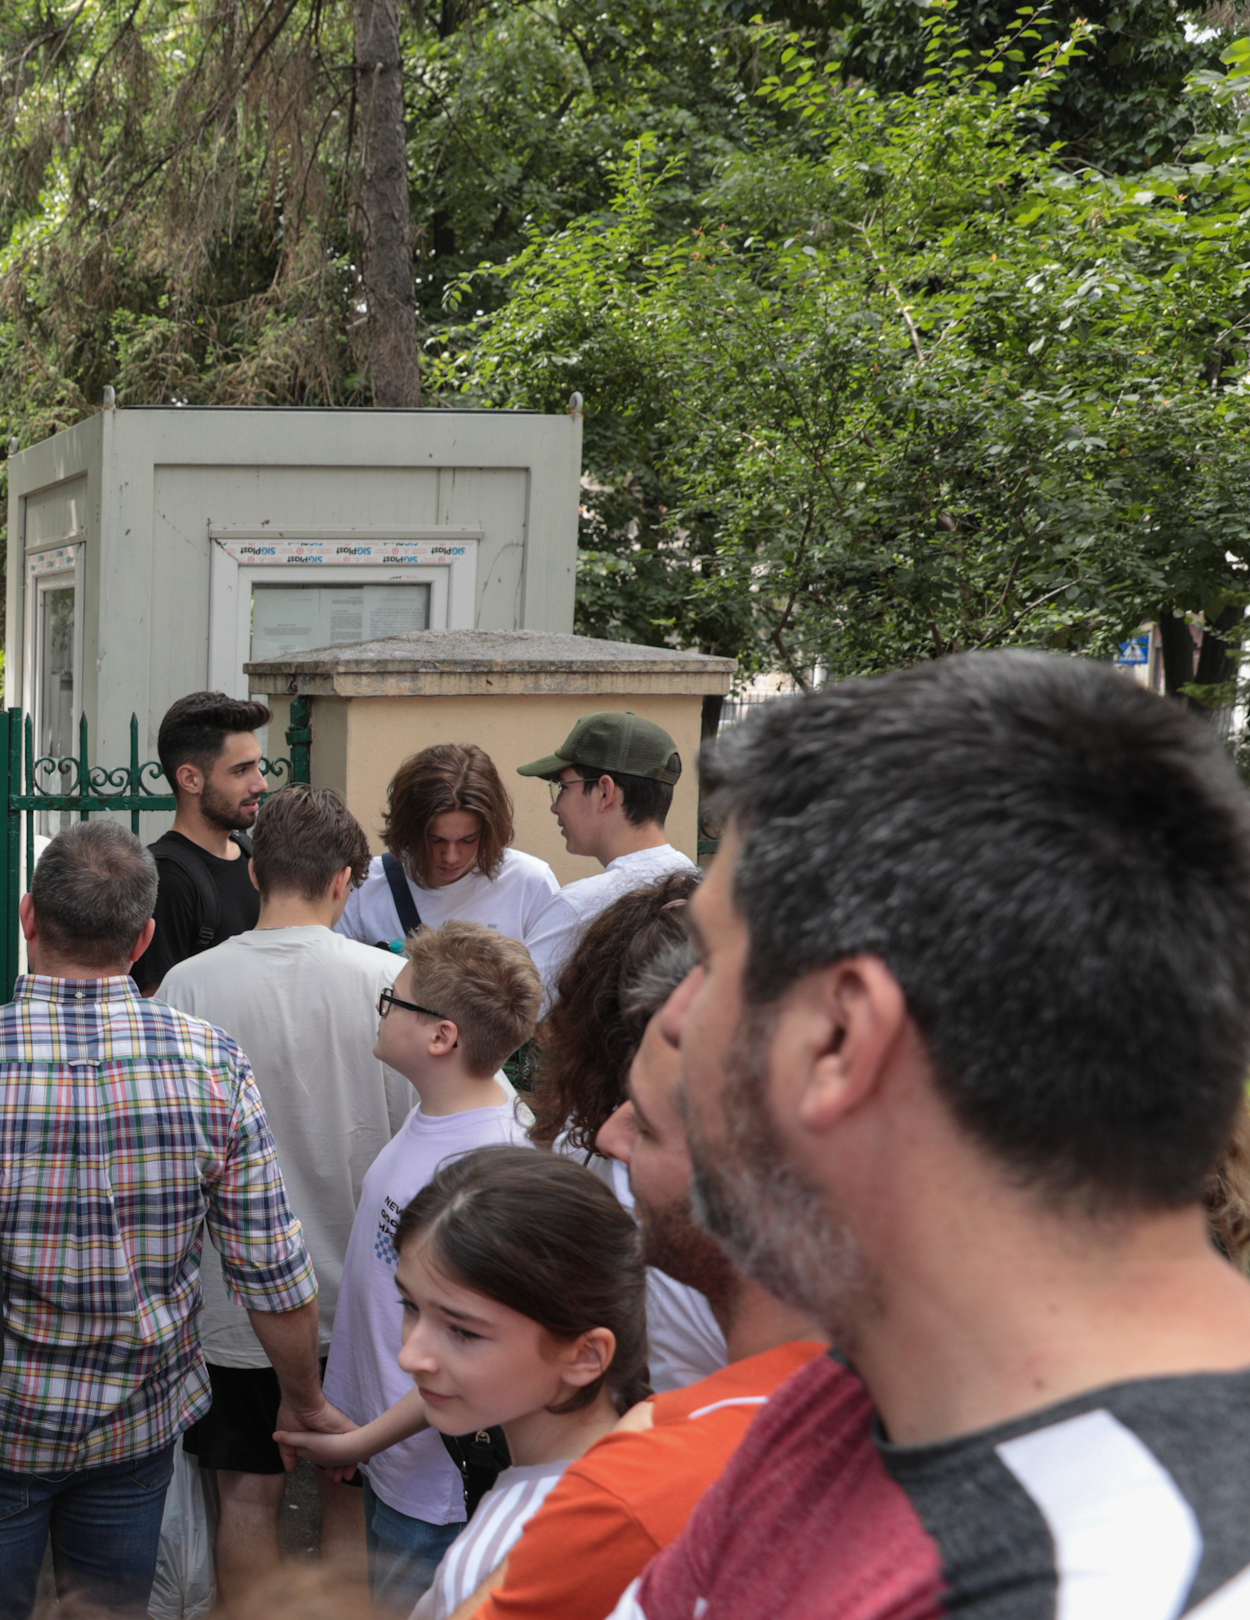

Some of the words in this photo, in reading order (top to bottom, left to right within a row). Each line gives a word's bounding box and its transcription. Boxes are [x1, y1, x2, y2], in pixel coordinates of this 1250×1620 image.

[240, 547, 276, 555] SIGPlast
[336, 547, 372, 555] SIGPlast
[431, 546, 466, 555] SIGPlast
